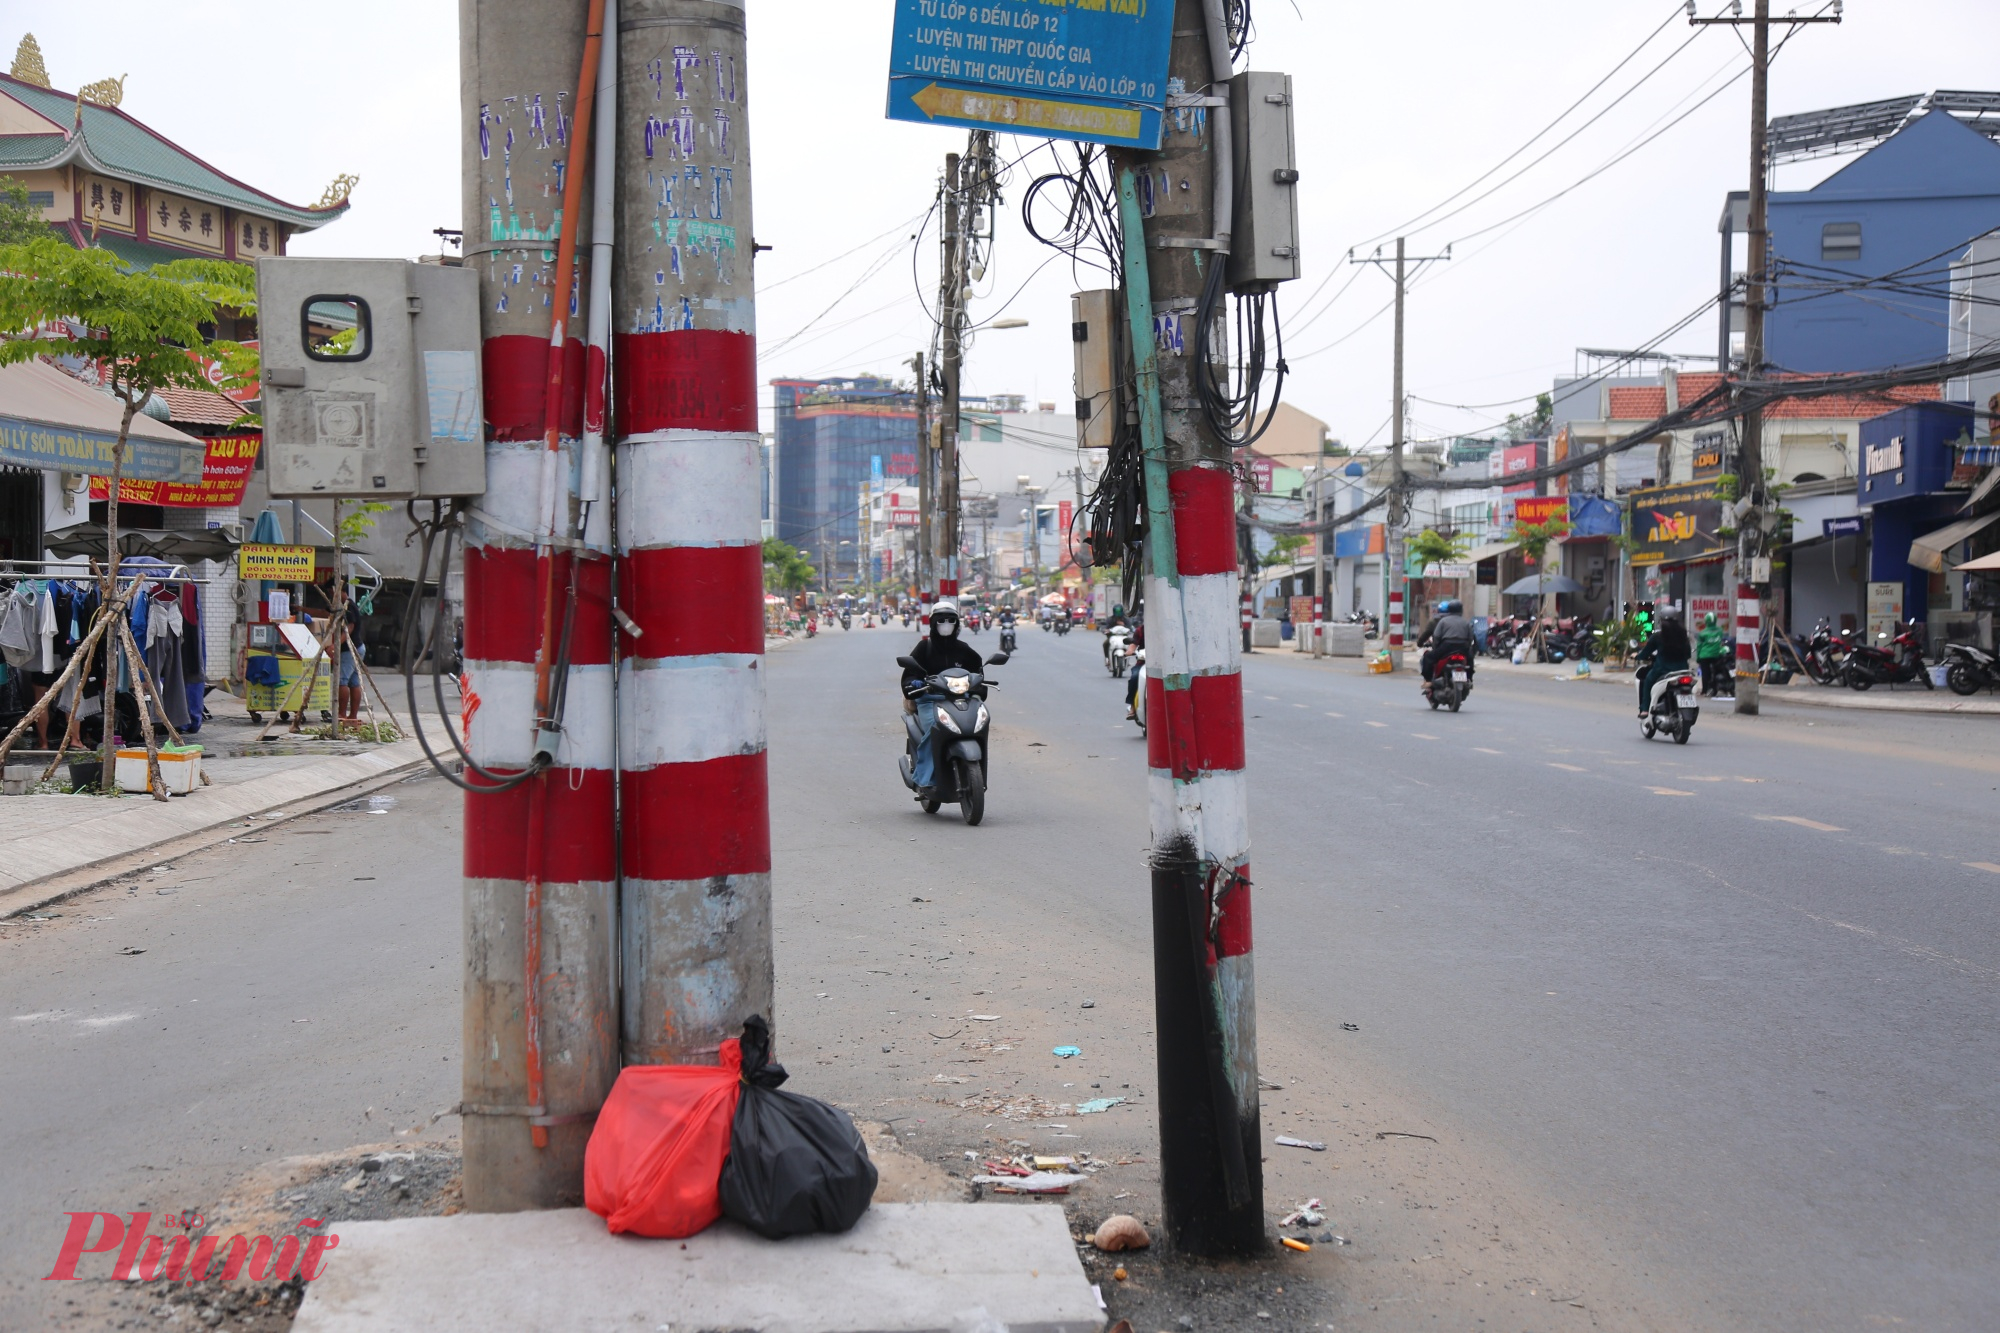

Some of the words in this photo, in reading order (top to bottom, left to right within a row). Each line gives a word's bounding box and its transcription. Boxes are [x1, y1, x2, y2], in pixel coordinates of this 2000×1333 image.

[940, 0, 967, 20] LỚP
[969, 7, 978, 23] 6
[981, 2, 1010, 26] ĐẾN
[1013, 9, 1040, 30] LỚP
[1044, 17, 1058, 33] 12
[916, 27, 963, 52] LUYỆN
[966, 34, 987, 51] THI
[990, 36, 1024, 56] THPT
[1027, 37, 1065, 61] QUỐC
[1068, 47, 1092, 64] GIA
[914, 54, 961, 78] LUYỆN
[988, 62, 1045, 87] CHUYỂN
[1047, 66, 1077, 89] CẤP
[1078, 73, 1107, 93] VÀO
[1110, 72, 1136, 96] LỚP
[1140, 83, 1156, 98] 10
[12, 425, 28, 451] LÝ
[31, 430, 55, 455] SƠN
[57, 432, 95, 460] TOÀN
[1865, 436, 1903, 476] Vinamilk
[1517, 502, 1535, 518] VĂN
[1648, 527, 1658, 542] A
[243, 545, 263, 554] ĐẠI
[266, 545, 278, 554] LÝ
[247, 555, 274, 565] MINH
[1692, 598, 1715, 611] BÁNH
